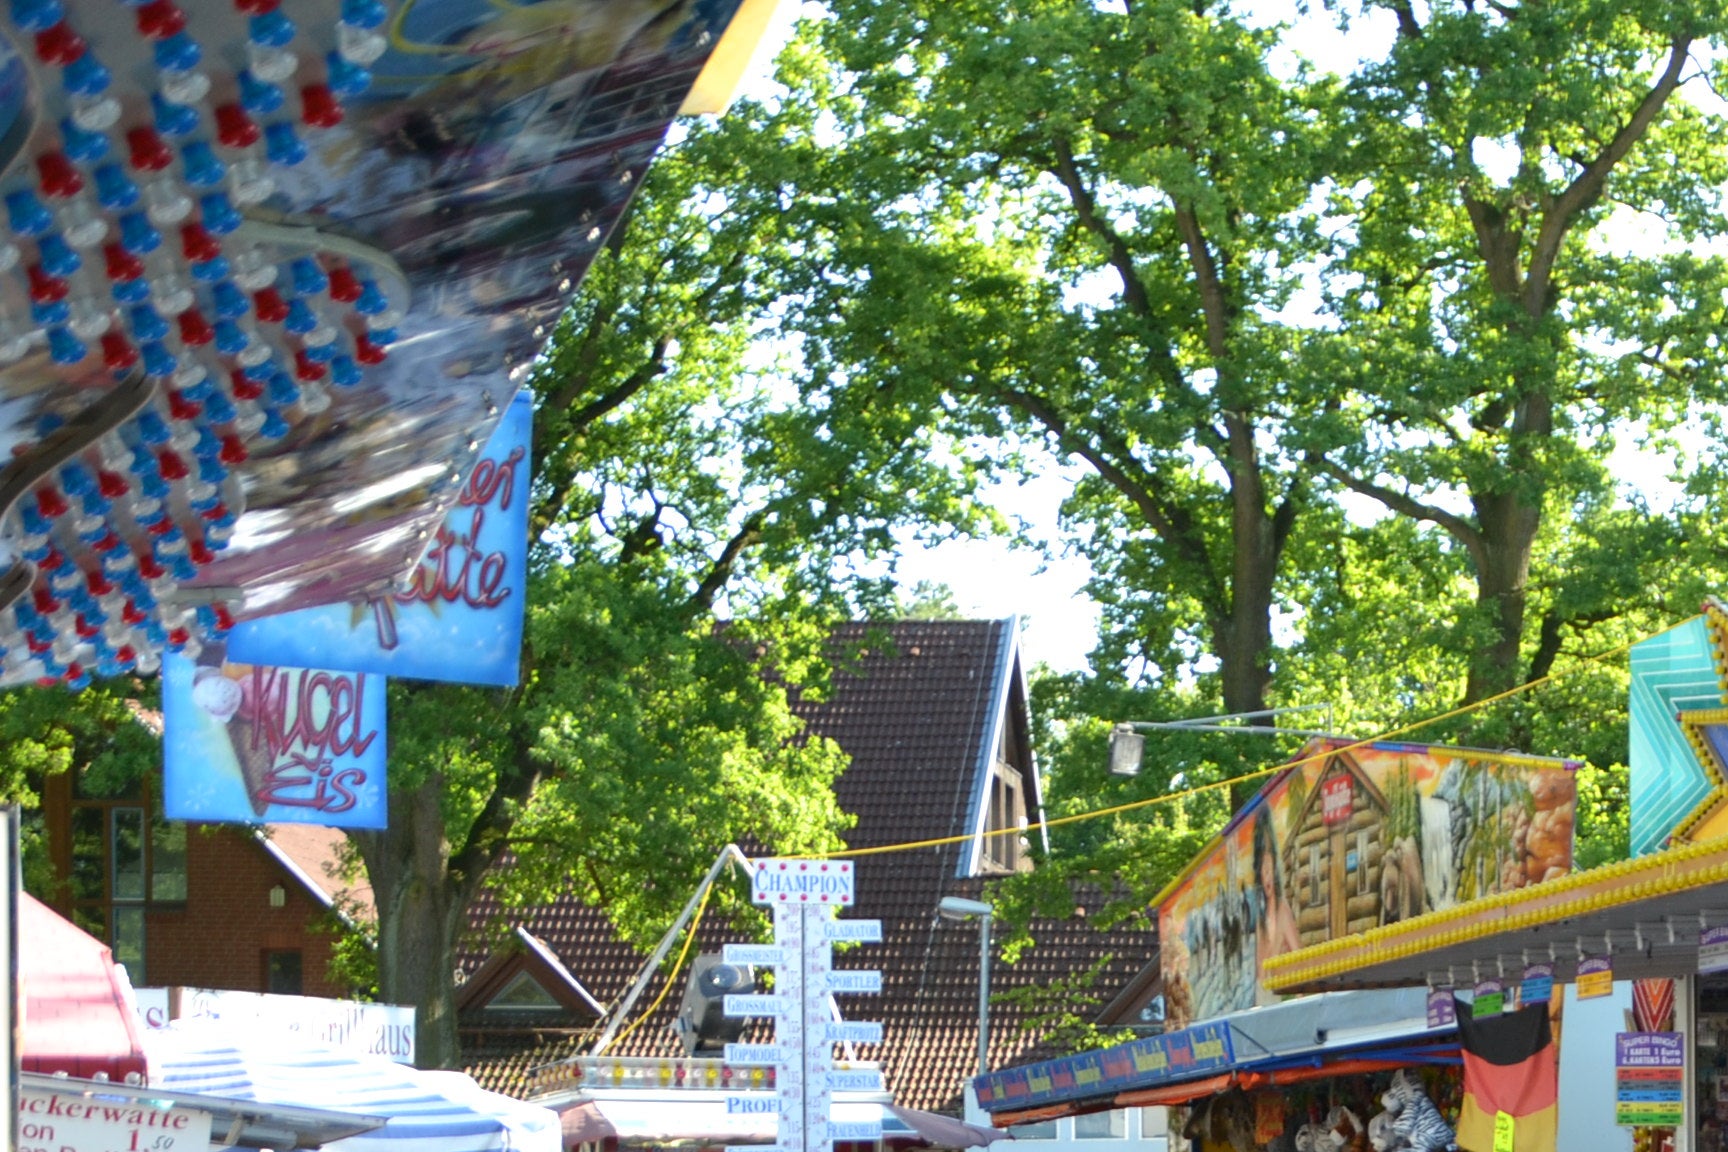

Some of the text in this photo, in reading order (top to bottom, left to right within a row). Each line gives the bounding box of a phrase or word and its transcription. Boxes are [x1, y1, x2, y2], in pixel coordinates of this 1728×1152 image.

[258, 758, 367, 813] Eis
[755, 869, 850, 893] CHAMPION
[727, 1097, 783, 1114] PROFI
